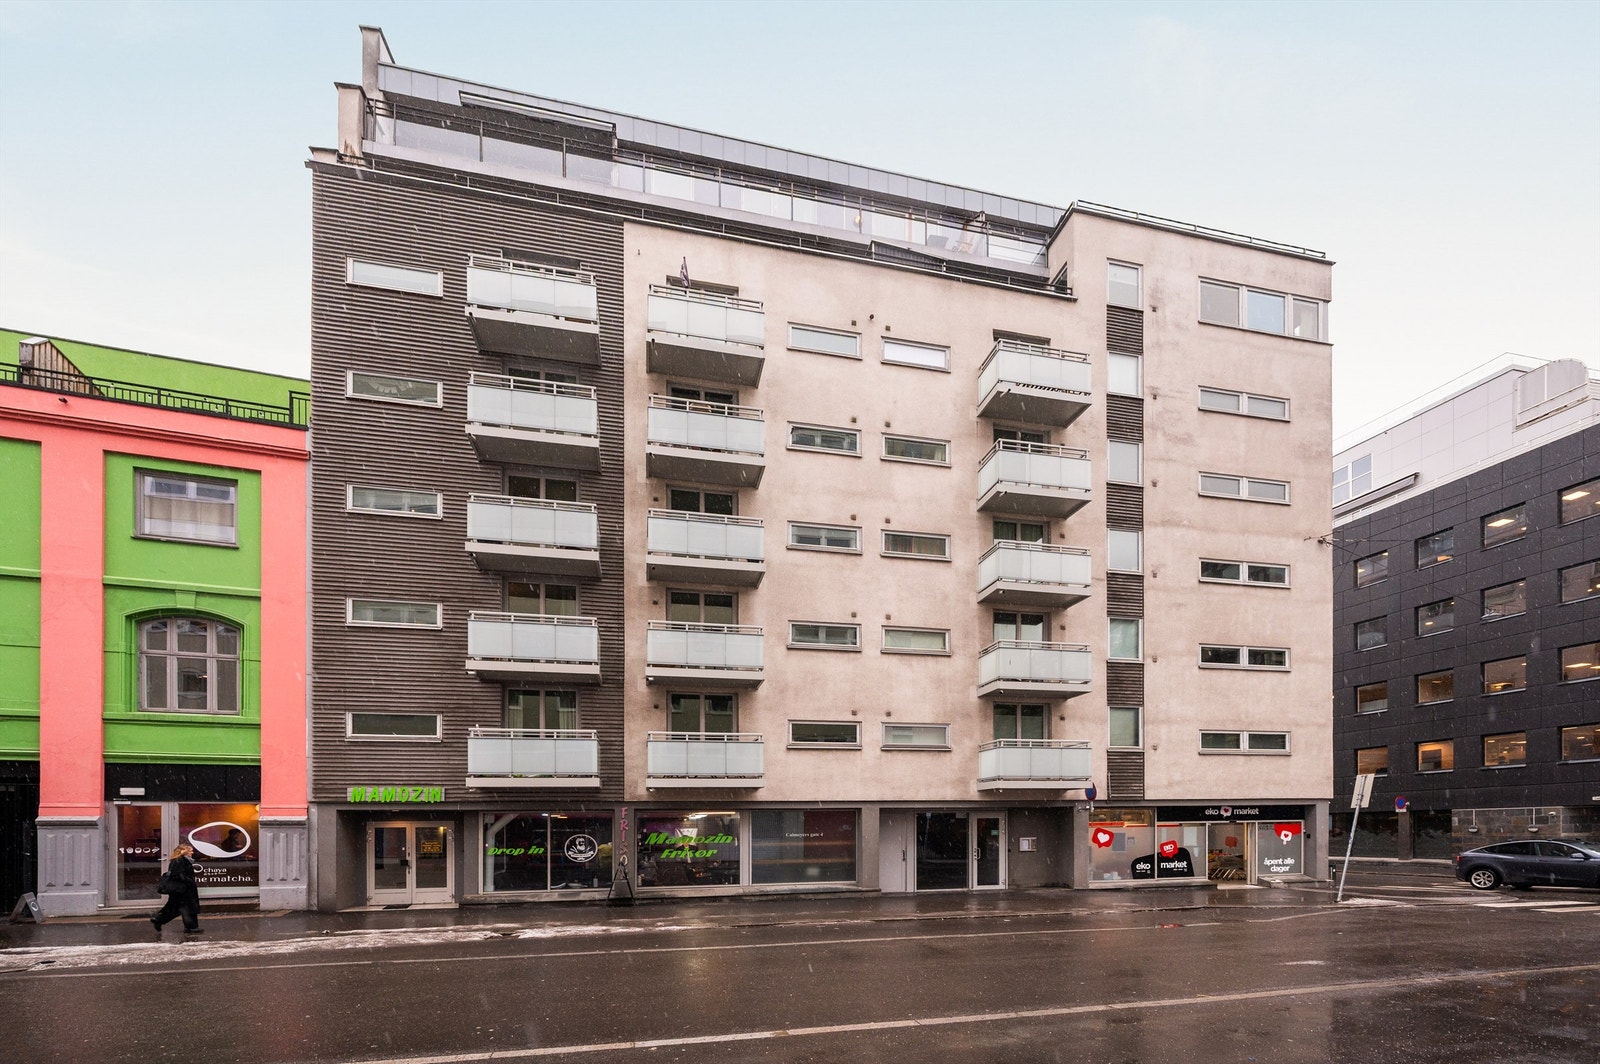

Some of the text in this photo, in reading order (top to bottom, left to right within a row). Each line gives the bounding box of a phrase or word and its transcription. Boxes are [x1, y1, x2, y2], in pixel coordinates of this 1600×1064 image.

[350, 786, 442, 803] MAMOZIN
[644, 832, 733, 845] Mamozin
[487, 845, 545, 856] Drop in
[1135, 860, 1188, 870] eko market
[1270, 865, 1290, 873] dager
